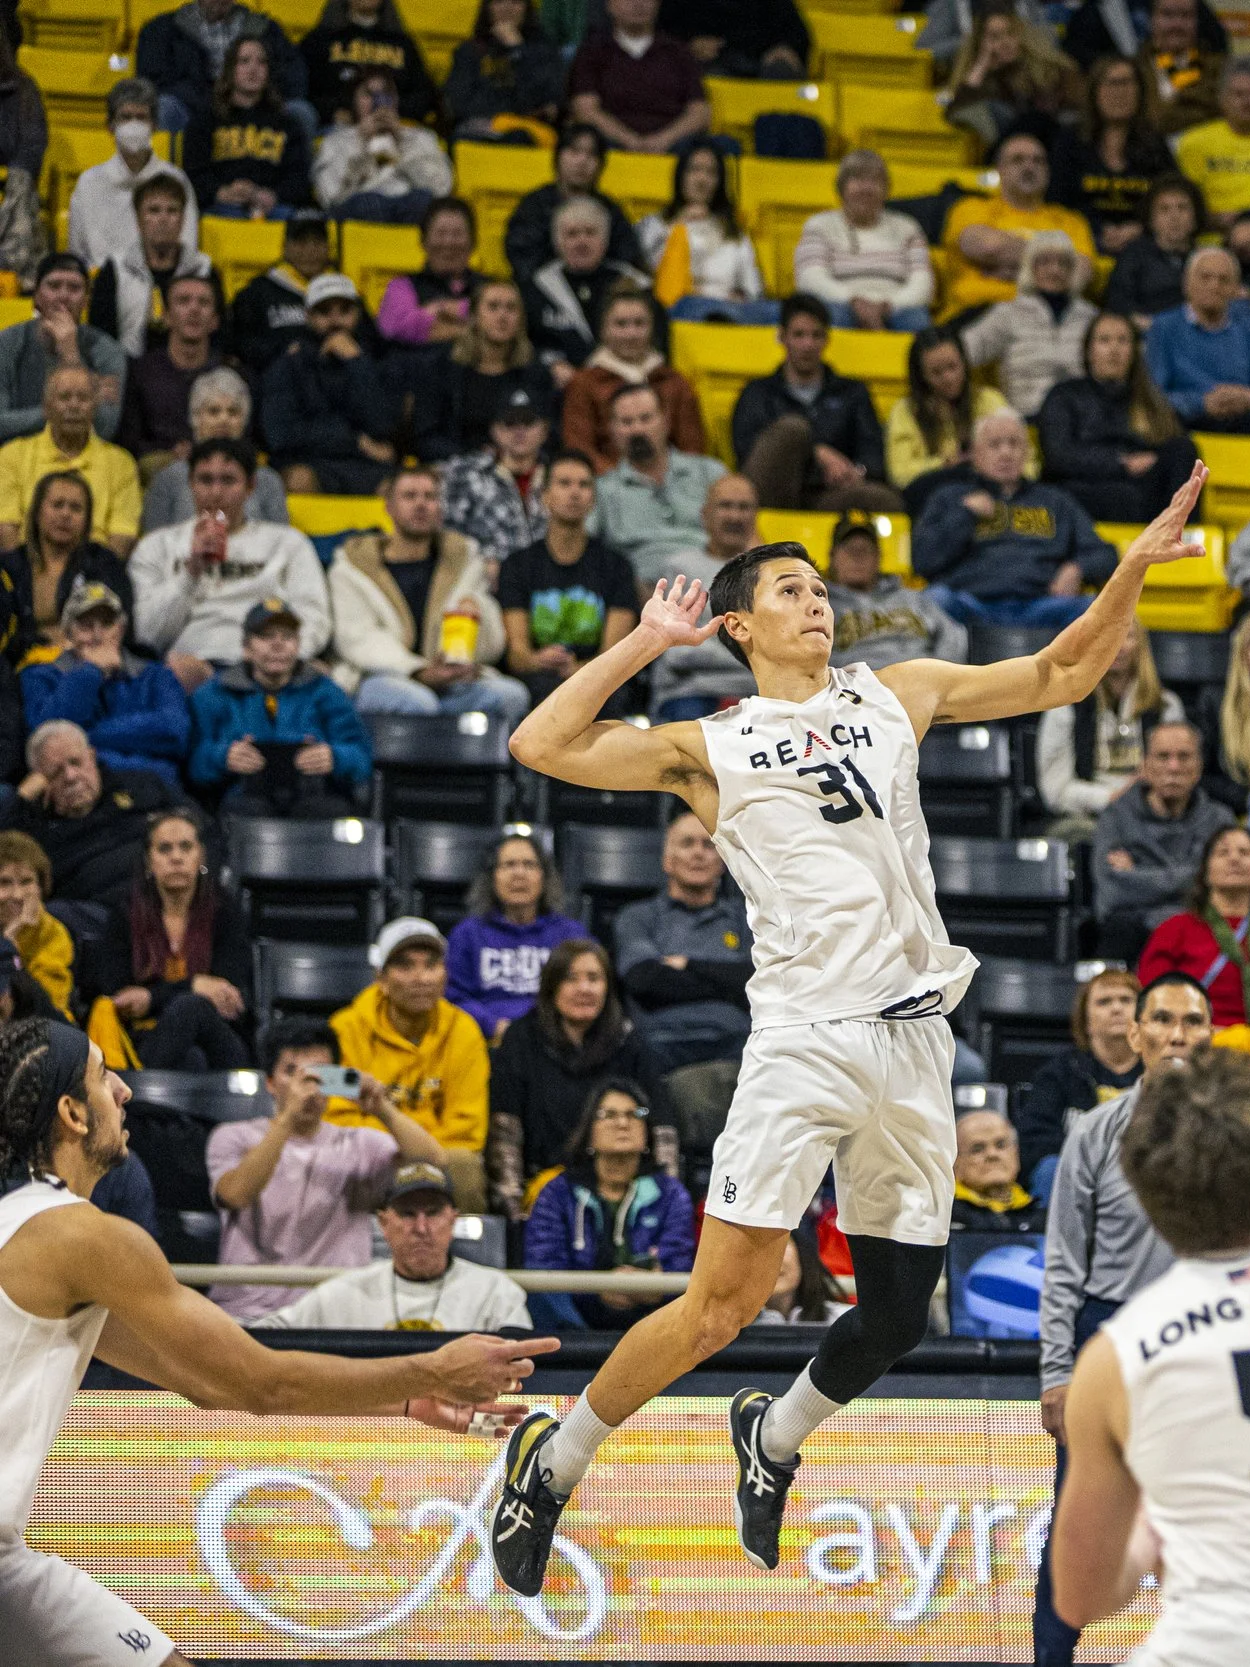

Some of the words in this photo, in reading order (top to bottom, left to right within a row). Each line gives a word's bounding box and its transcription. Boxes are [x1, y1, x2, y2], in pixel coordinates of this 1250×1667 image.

[750, 724, 873, 769] BEACH
[796, 754, 884, 824] 31
[1139, 1298, 1243, 1361] LONG
